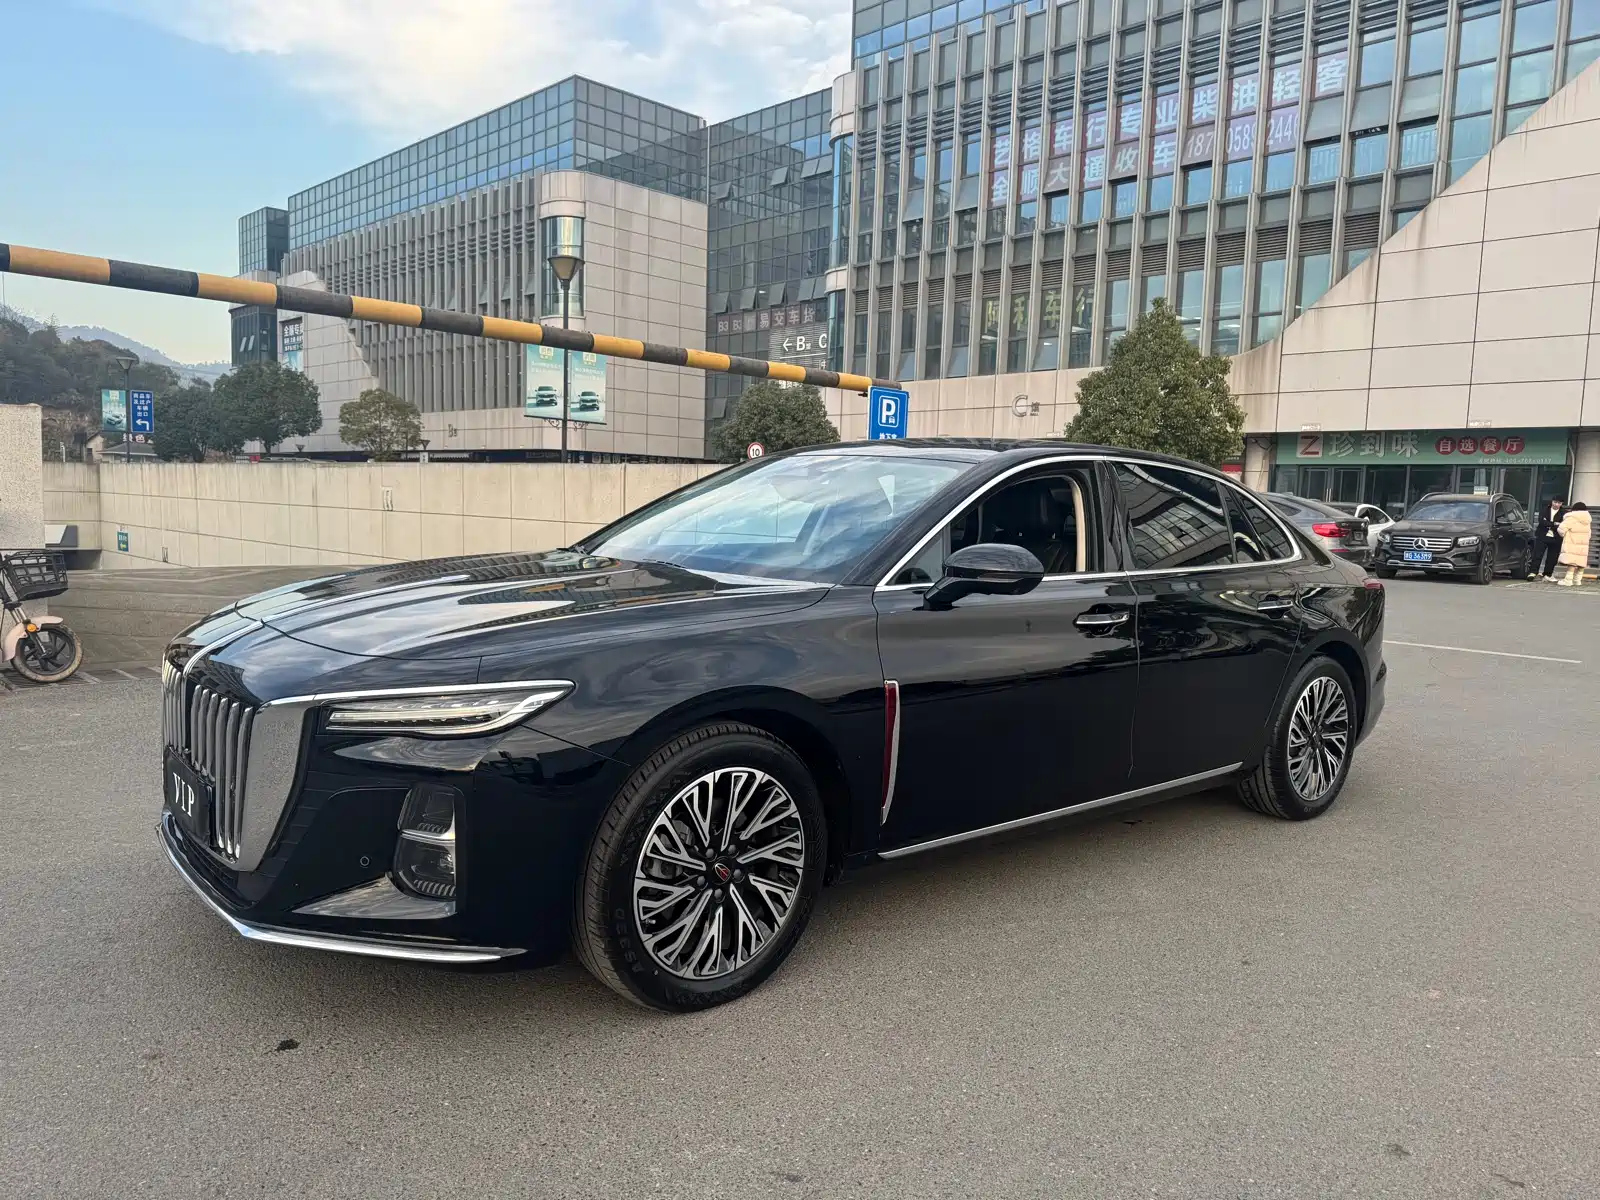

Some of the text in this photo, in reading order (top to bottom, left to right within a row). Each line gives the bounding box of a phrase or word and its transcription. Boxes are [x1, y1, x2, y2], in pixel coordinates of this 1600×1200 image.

[882, 398, 896, 424] P
[752, 448, 761, 457] 10
[1328, 432, 1521, 458] 珍到味 自选餐厅
[173, 771, 195, 818] VIP
